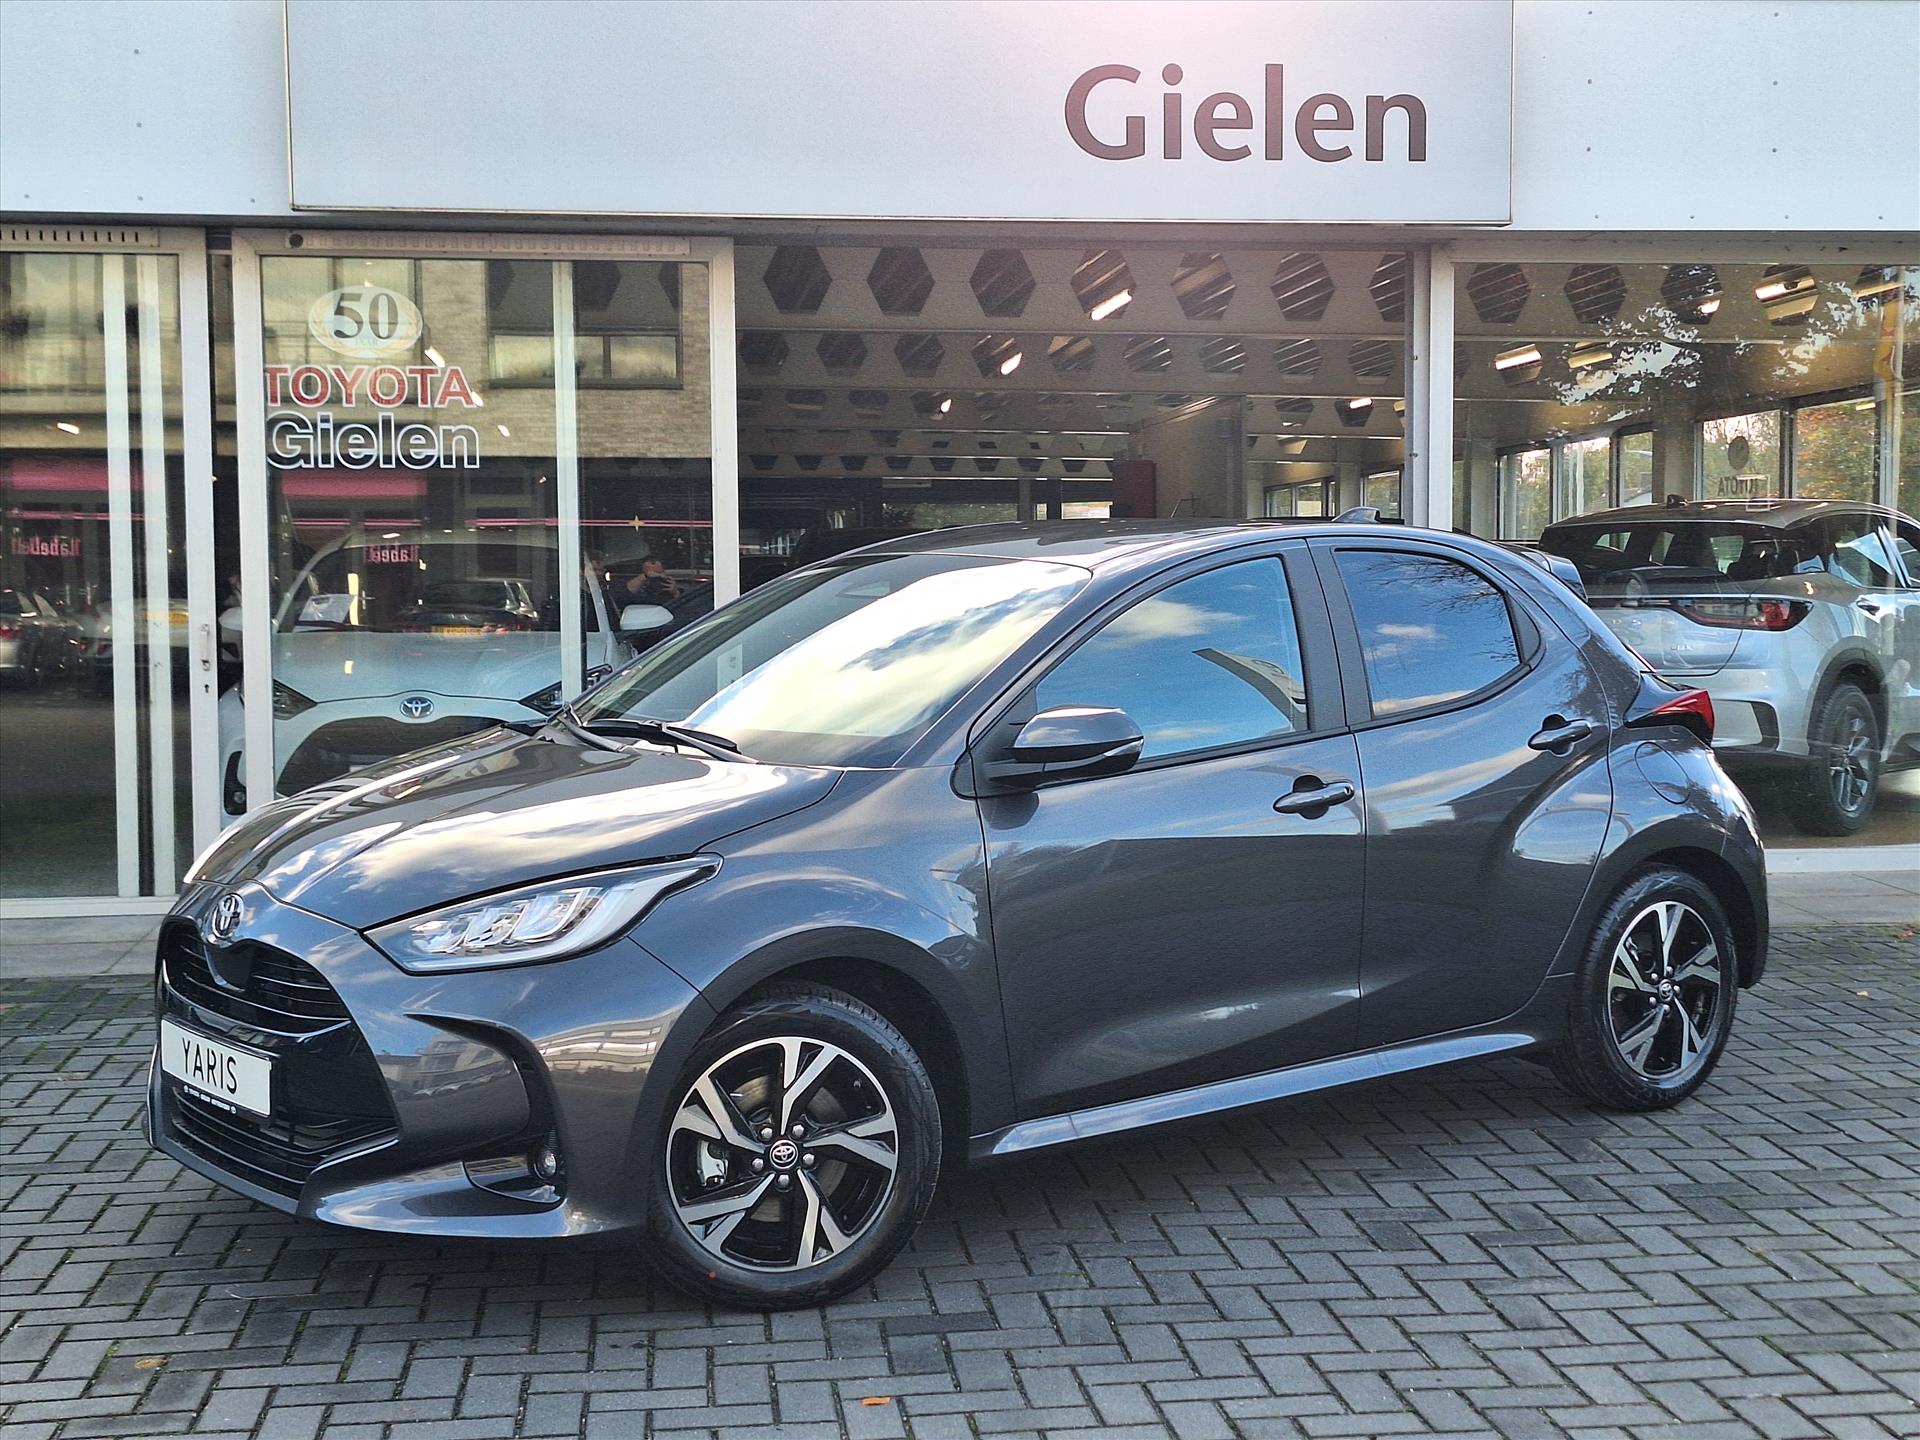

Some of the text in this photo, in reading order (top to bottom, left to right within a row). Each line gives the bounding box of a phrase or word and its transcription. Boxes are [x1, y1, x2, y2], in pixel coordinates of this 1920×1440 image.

[1064, 62, 1427, 163] Gielen
[333, 292, 400, 340] 50
[265, 363, 478, 408] TOYOTA
[265, 410, 480, 470] Gielen
[182, 1037, 238, 1095] YARIS
